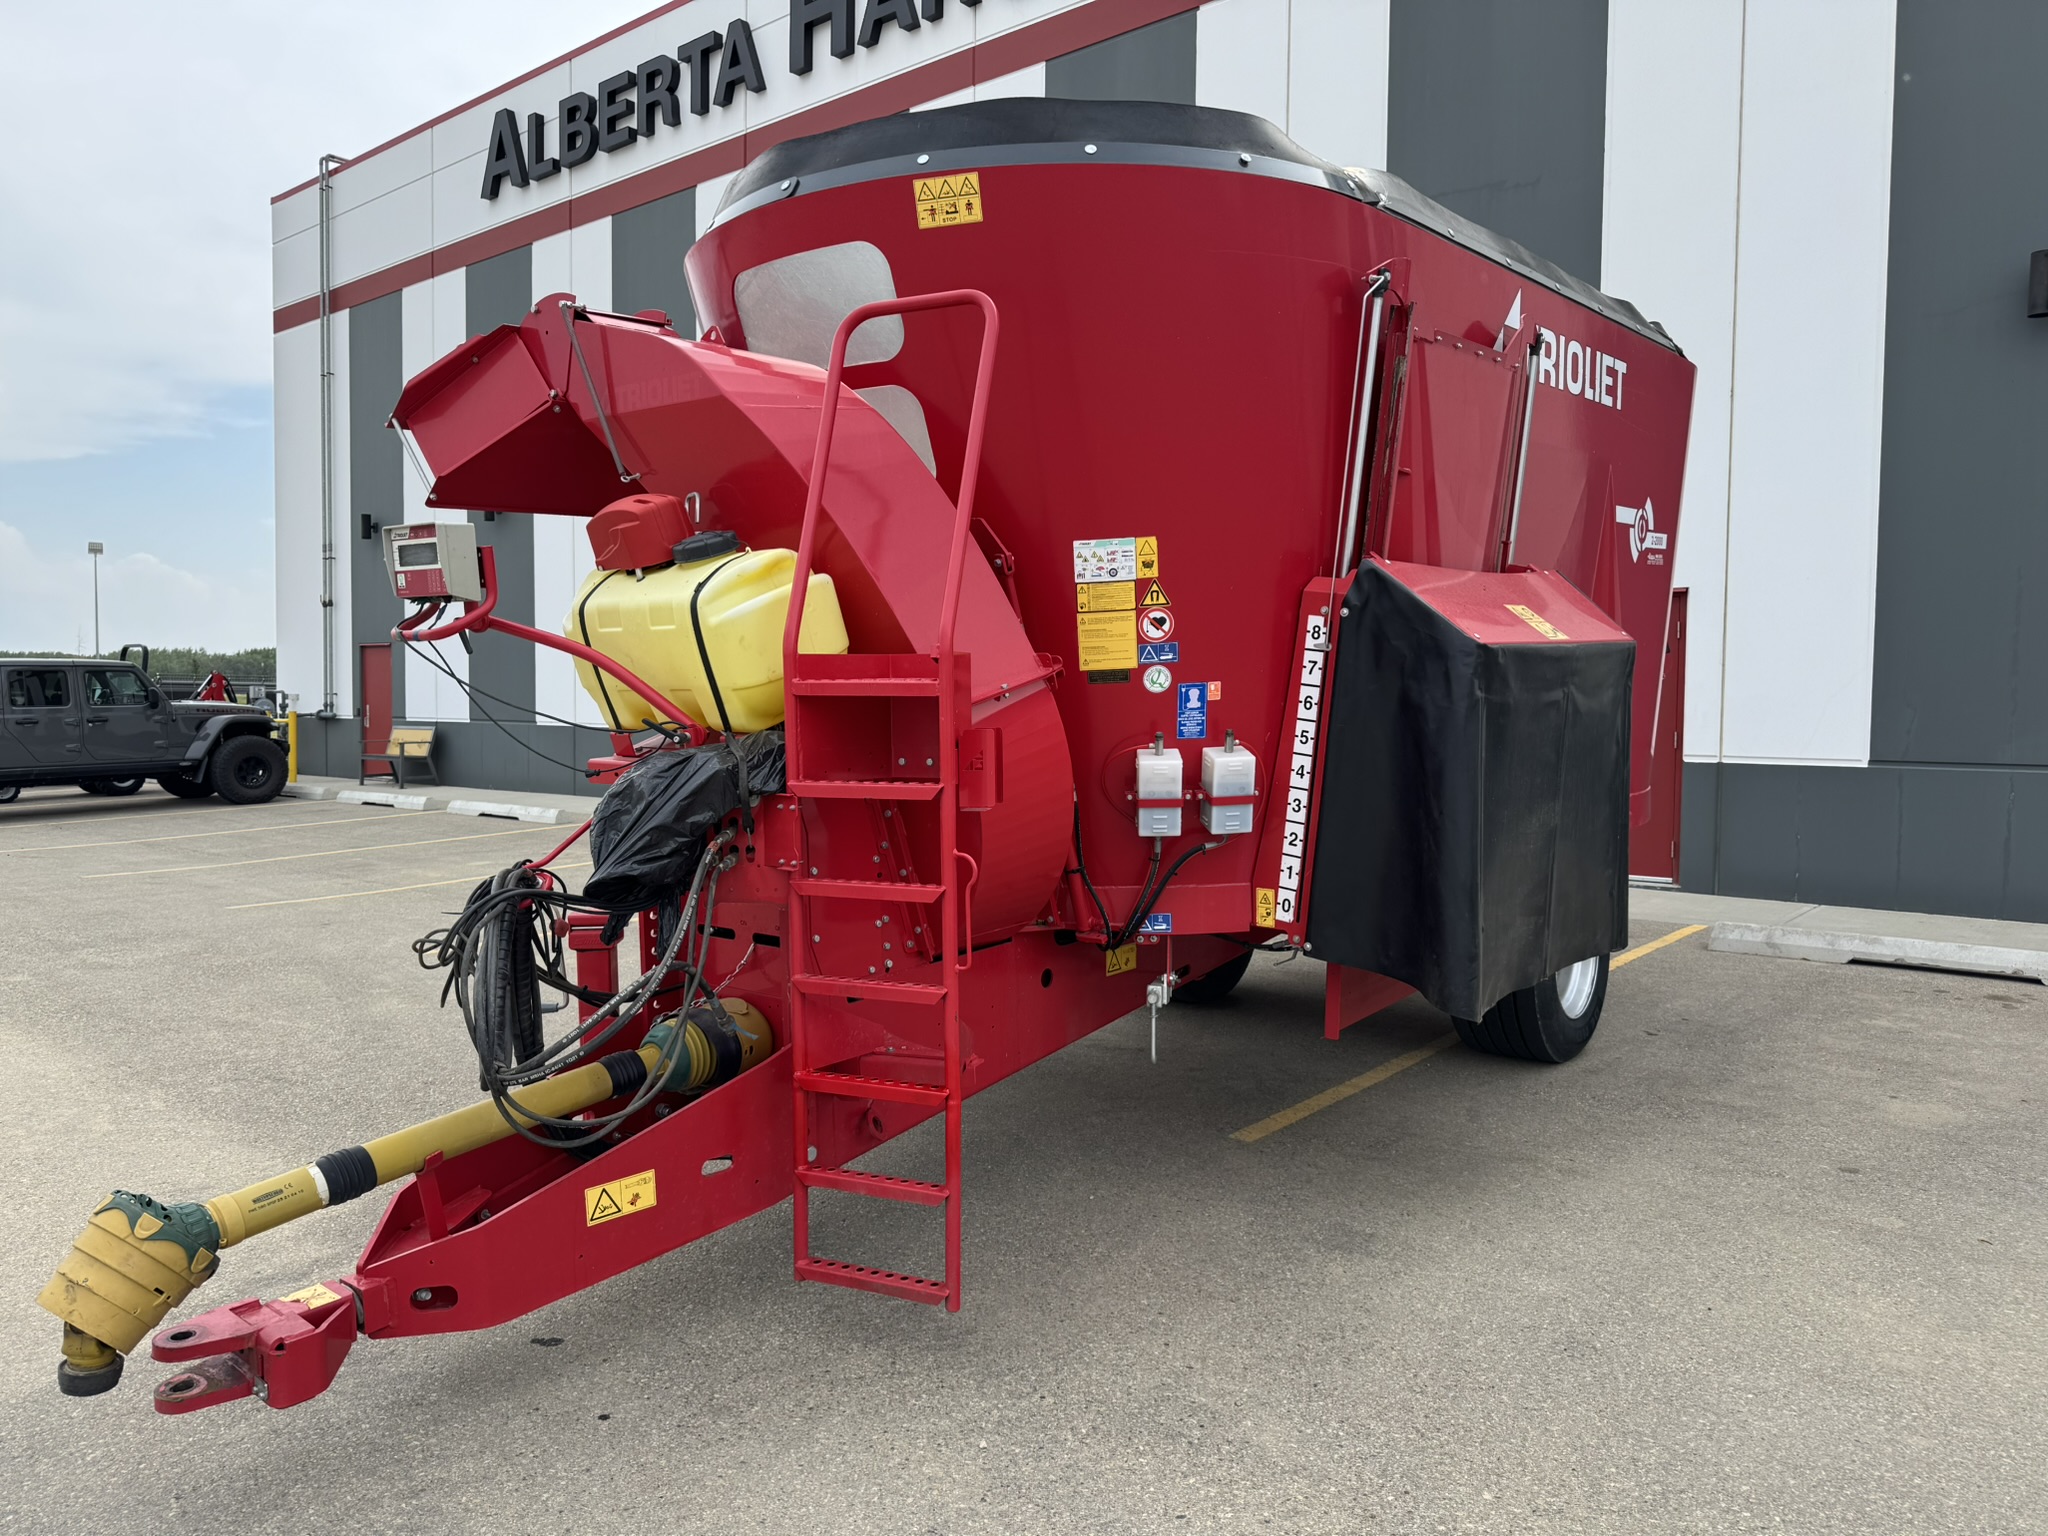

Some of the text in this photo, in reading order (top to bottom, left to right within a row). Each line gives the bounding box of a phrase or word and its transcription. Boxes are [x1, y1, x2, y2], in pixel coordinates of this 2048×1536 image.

[481, 0, 983, 201] ALBERTA HA
[1527, 324, 1628, 411] RIOLIET
[1311, 624, 1321, 640] 8
[1307, 660, 1318, 675] 7
[1303, 695, 1313, 711] 6
[1299, 730, 1309, 745] 5
[1295, 764, 1305, 779] 4
[1291, 798, 1301, 813] 3
[1288, 832, 1298, 847] 2
[1286, 865, 1293, 880] 1
[1281, 898, 1291, 913] 0
